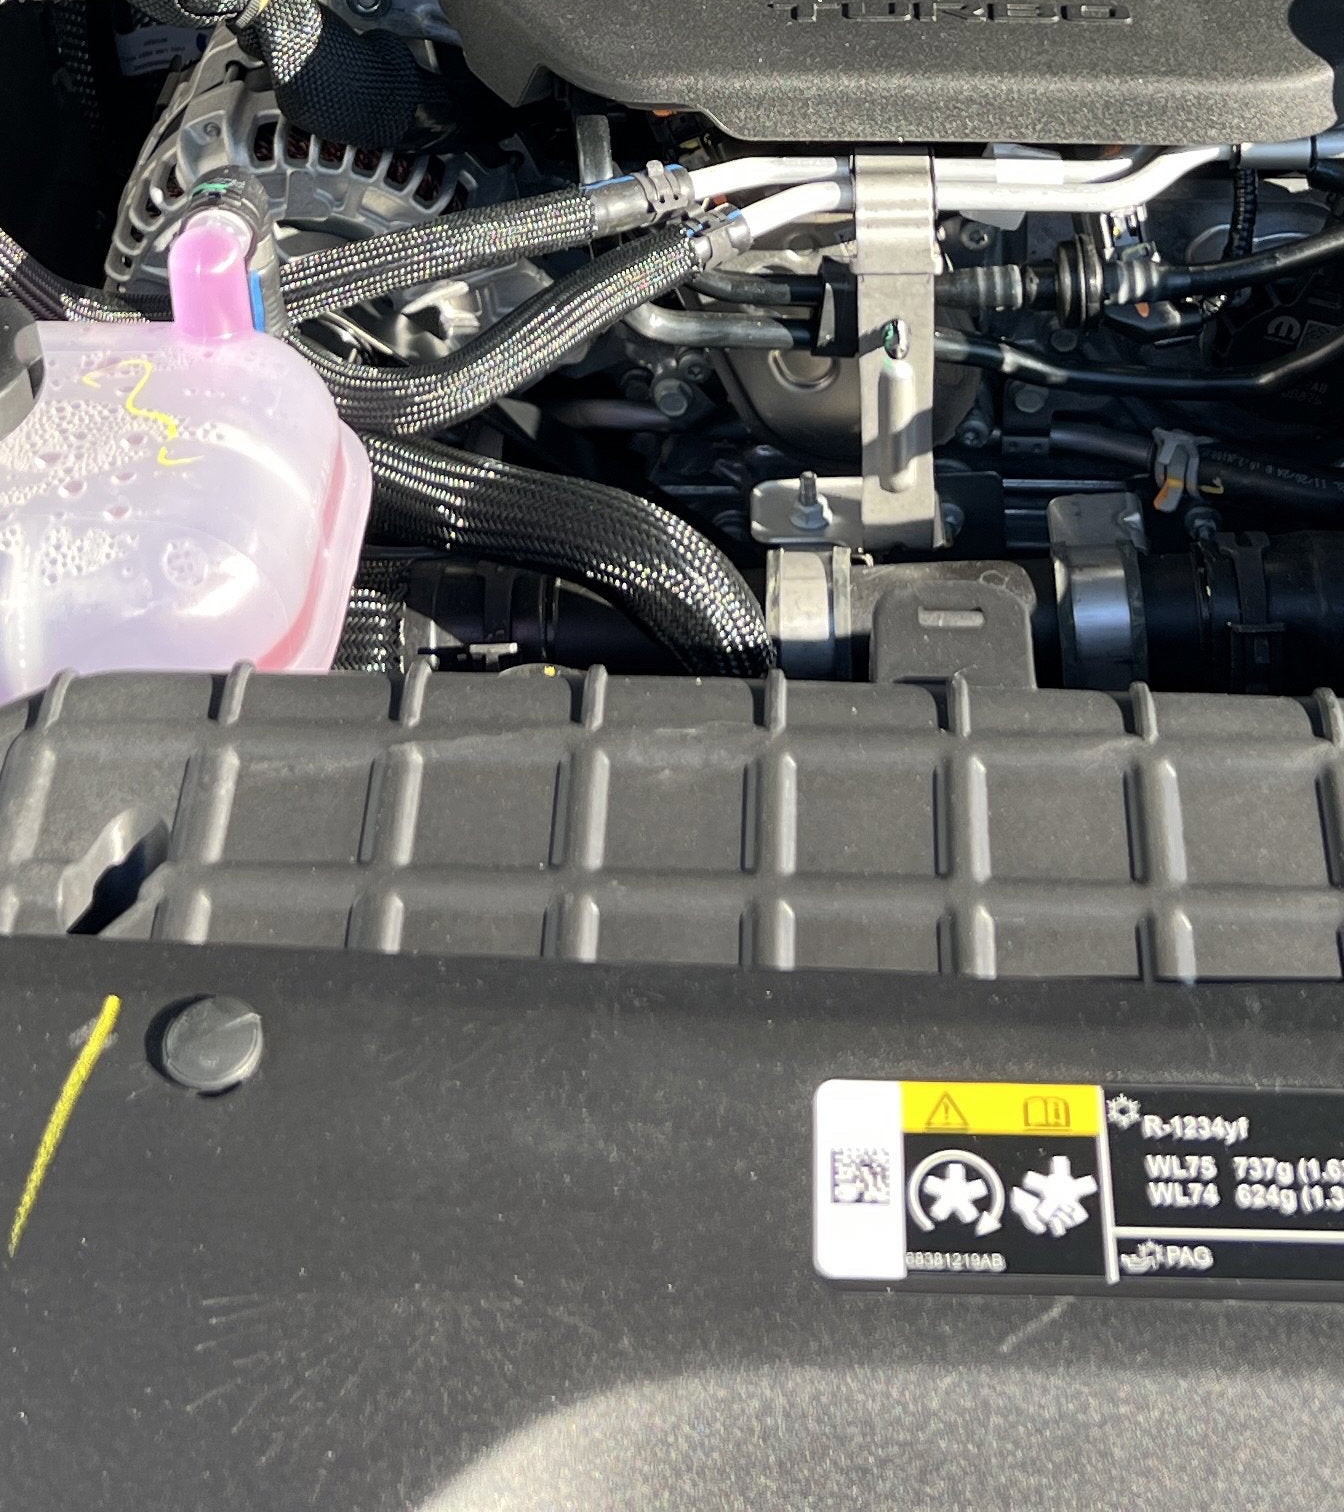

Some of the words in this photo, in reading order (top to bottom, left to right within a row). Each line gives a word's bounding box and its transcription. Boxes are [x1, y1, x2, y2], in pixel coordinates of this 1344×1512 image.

[767, 1, 1133, 23] TURBO
[1142, 1114, 1250, 1146] R-1234yf
[1145, 1154, 1218, 1181] WL75
[1233, 1156, 1295, 1186] 737g
[1146, 1182, 1221, 1209] WL74
[1234, 1183, 1298, 1216] 624g
[1166, 1244, 1215, 1273] PAG
